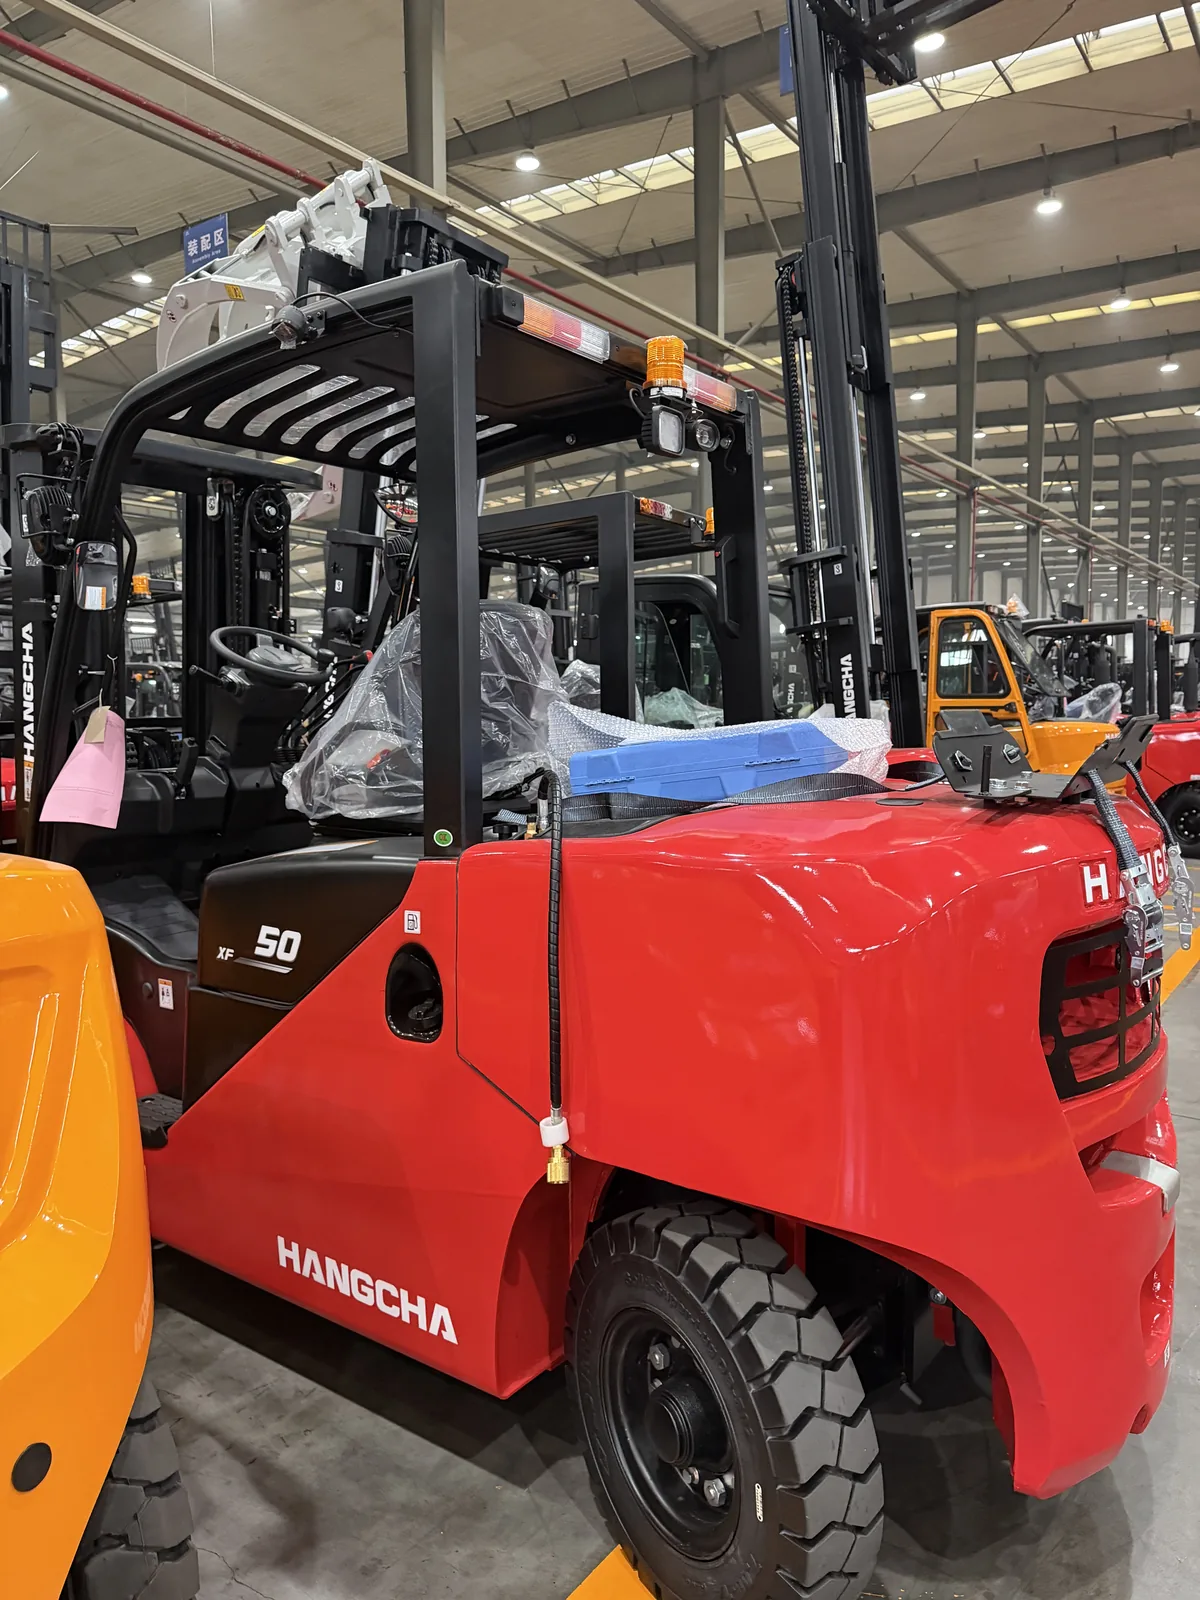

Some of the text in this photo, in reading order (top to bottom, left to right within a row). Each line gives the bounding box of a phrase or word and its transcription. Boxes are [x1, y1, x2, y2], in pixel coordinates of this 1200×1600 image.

[187, 228, 225, 257] 装配区
[21, 621, 35, 763] HANGCHA
[216, 946, 235, 961] XF
[254, 924, 302, 963] 50
[276, 1235, 459, 1345] HANGCHA
